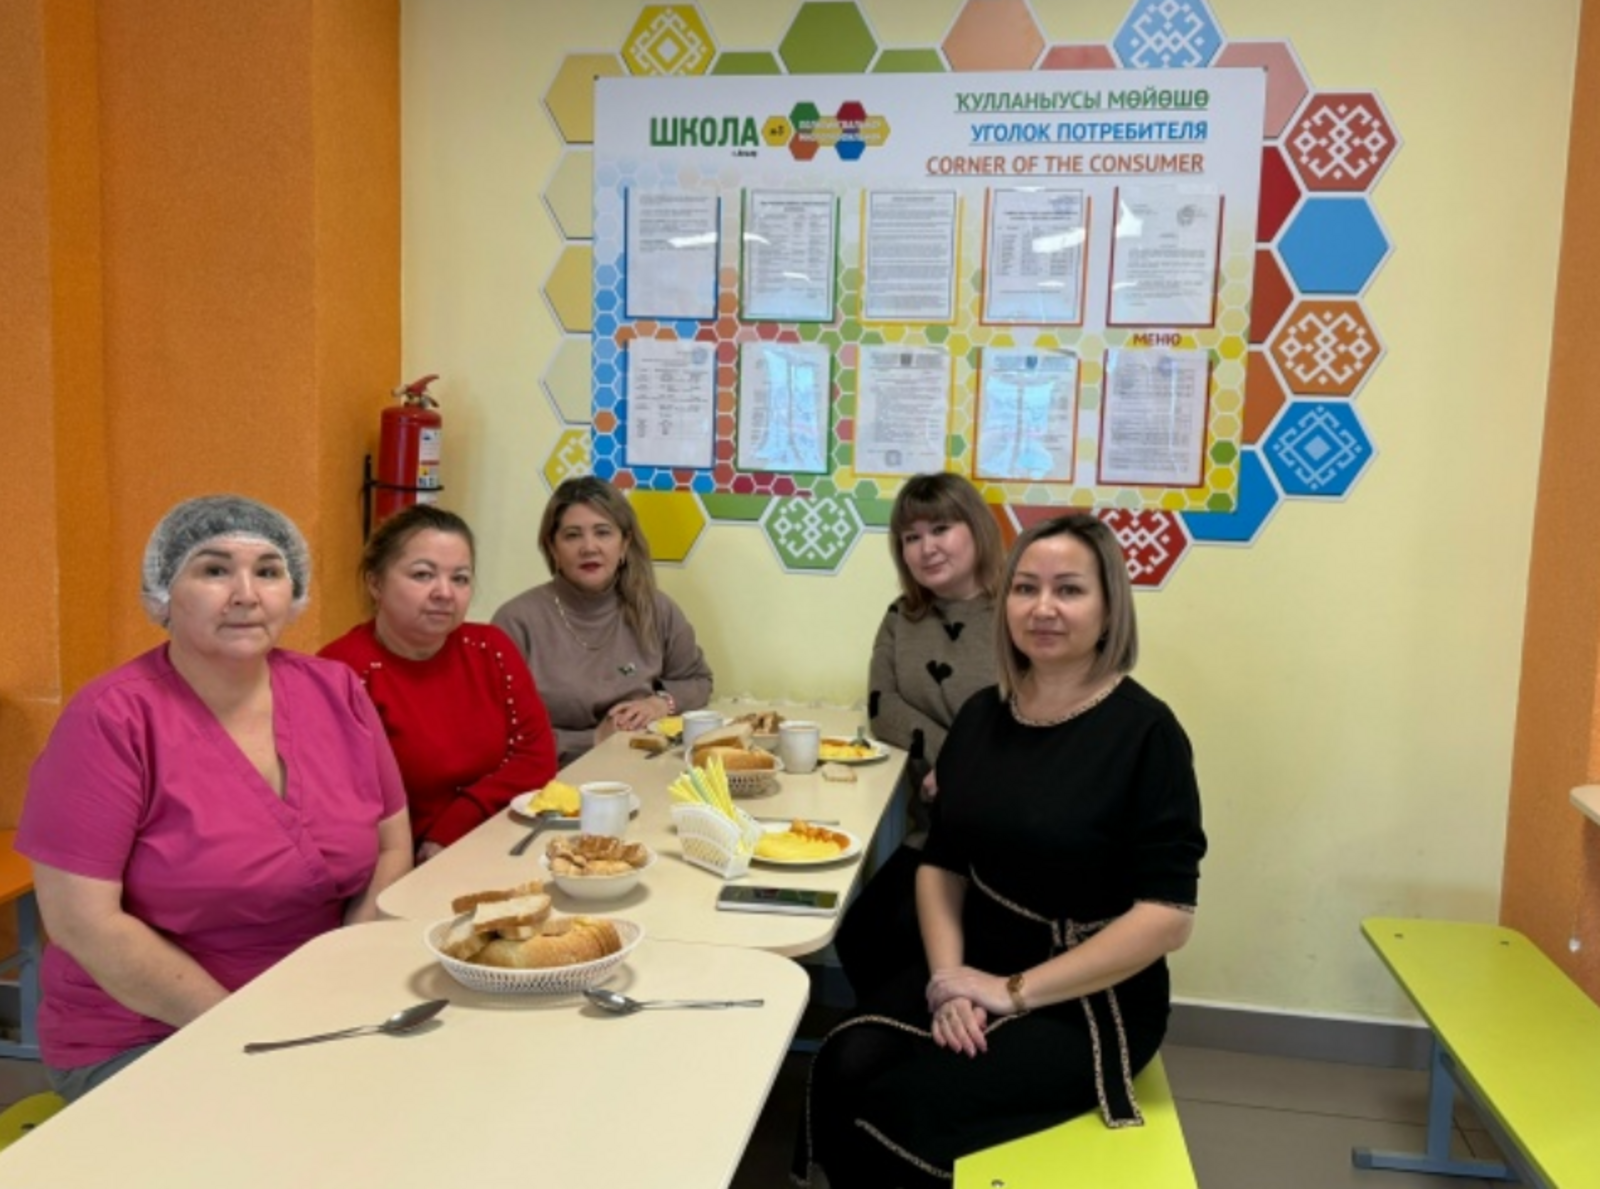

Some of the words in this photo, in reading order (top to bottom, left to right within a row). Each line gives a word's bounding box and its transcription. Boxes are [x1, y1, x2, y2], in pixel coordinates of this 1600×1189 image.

[956, 91, 1101, 111] ҠУЛЛАНЫУСЫ
[1108, 87, 1210, 108] МӨЙӨШӨ
[650, 117, 760, 147] ШКОЛА
[971, 123, 1050, 142] УГОЛОК
[1057, 121, 1208, 140] ПОТРЕБИТЕЛЯ
[926, 155, 1005, 174] CORNER
[1012, 155, 1037, 173] OF
[1044, 154, 1083, 173] THE
[1090, 153, 1205, 173] CONSUMER
[1133, 333, 1182, 347] МЕНЮ
